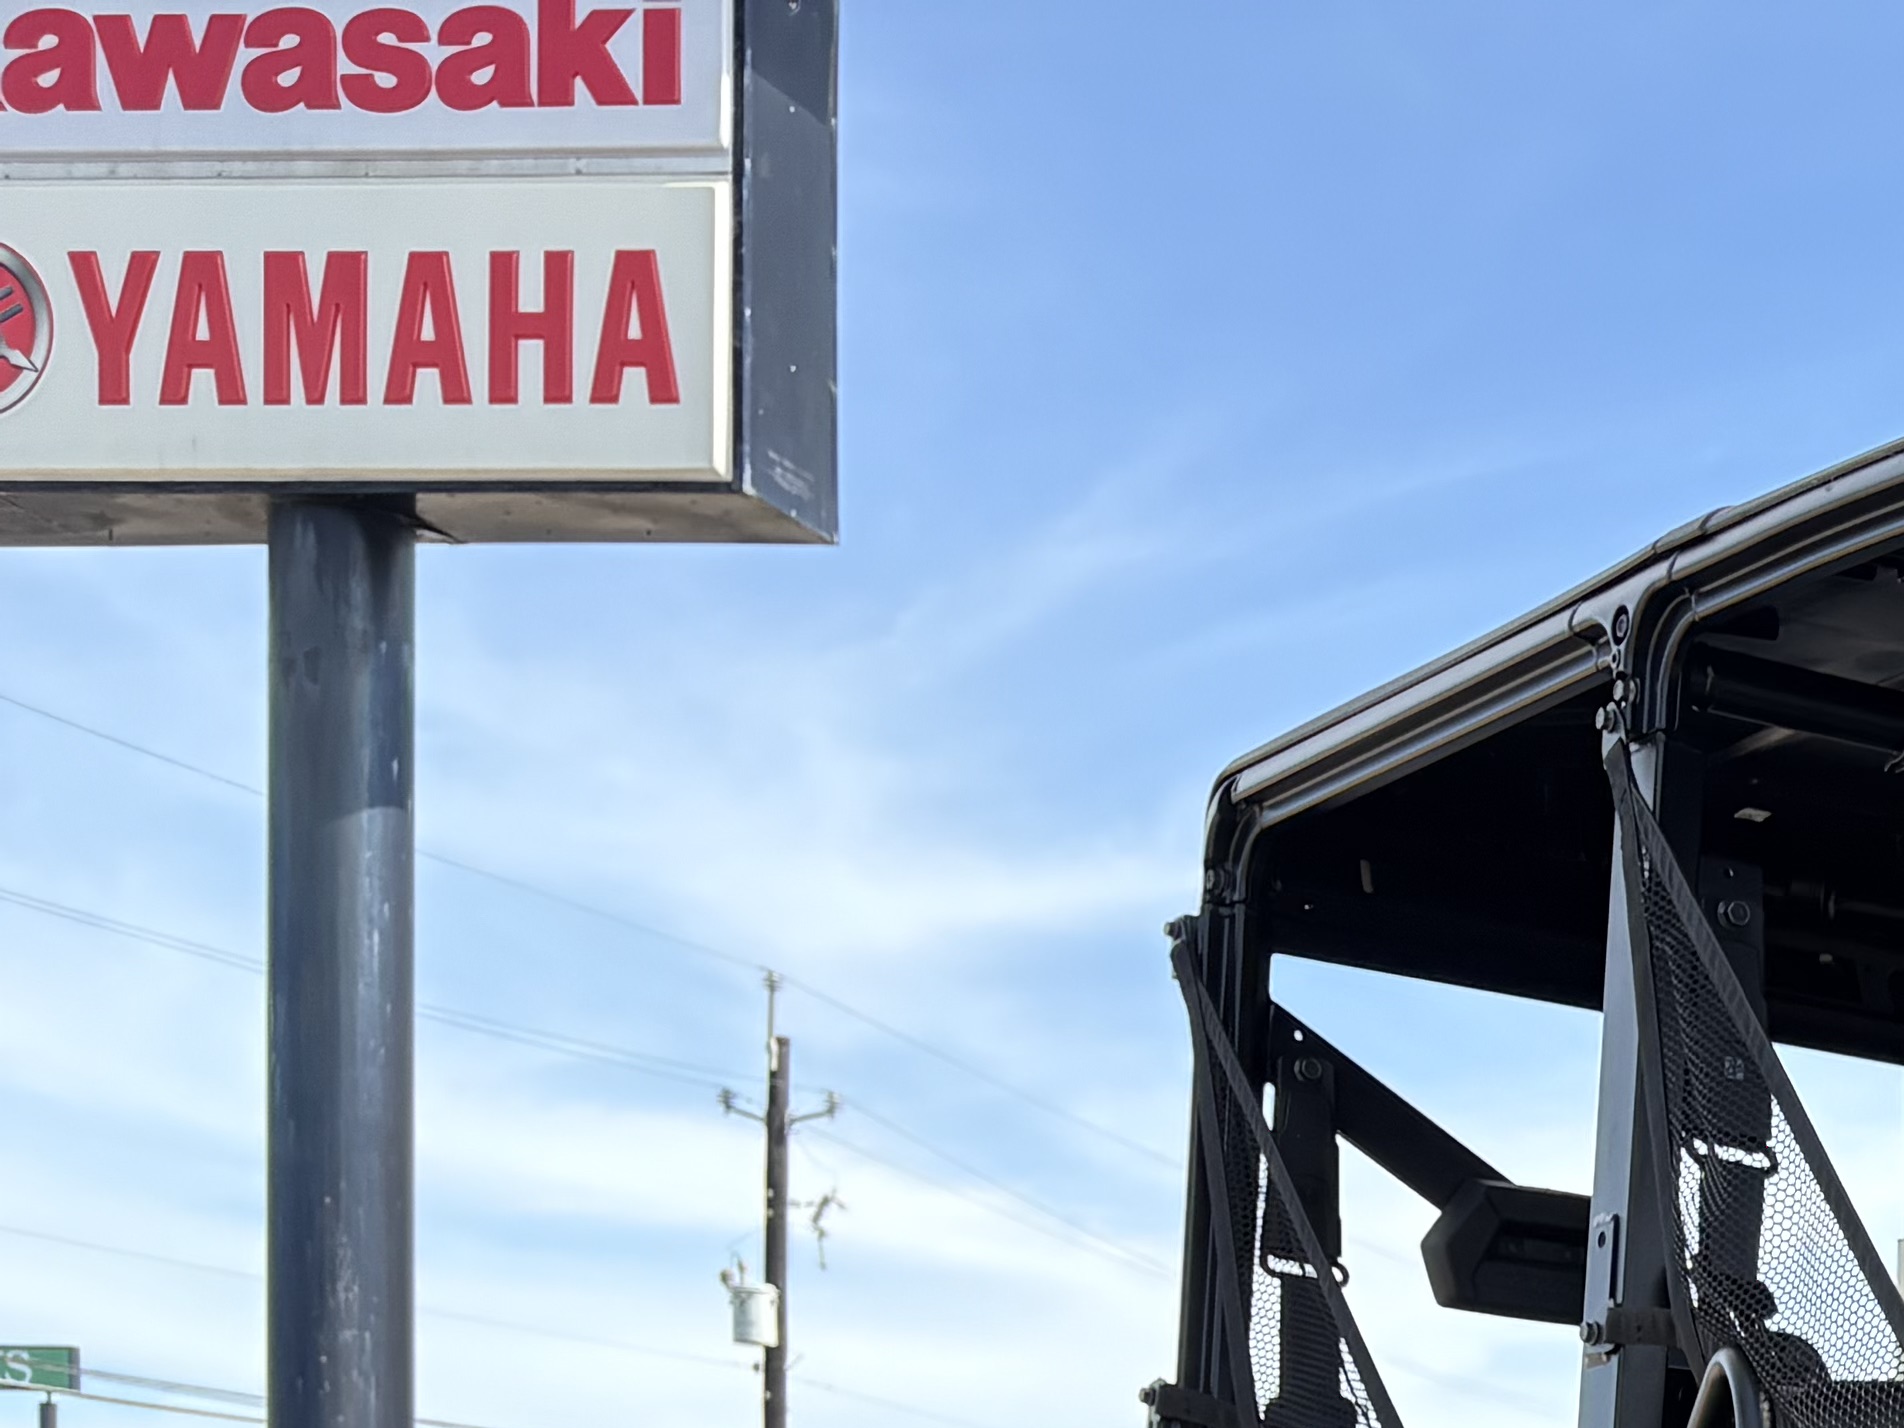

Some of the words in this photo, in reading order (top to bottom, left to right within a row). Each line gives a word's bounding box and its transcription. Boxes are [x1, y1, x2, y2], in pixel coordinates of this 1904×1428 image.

[0, 0, 683, 113] awasaki
[67, 249, 682, 407] YAMAHA
[0, 1349, 33, 1385] S
